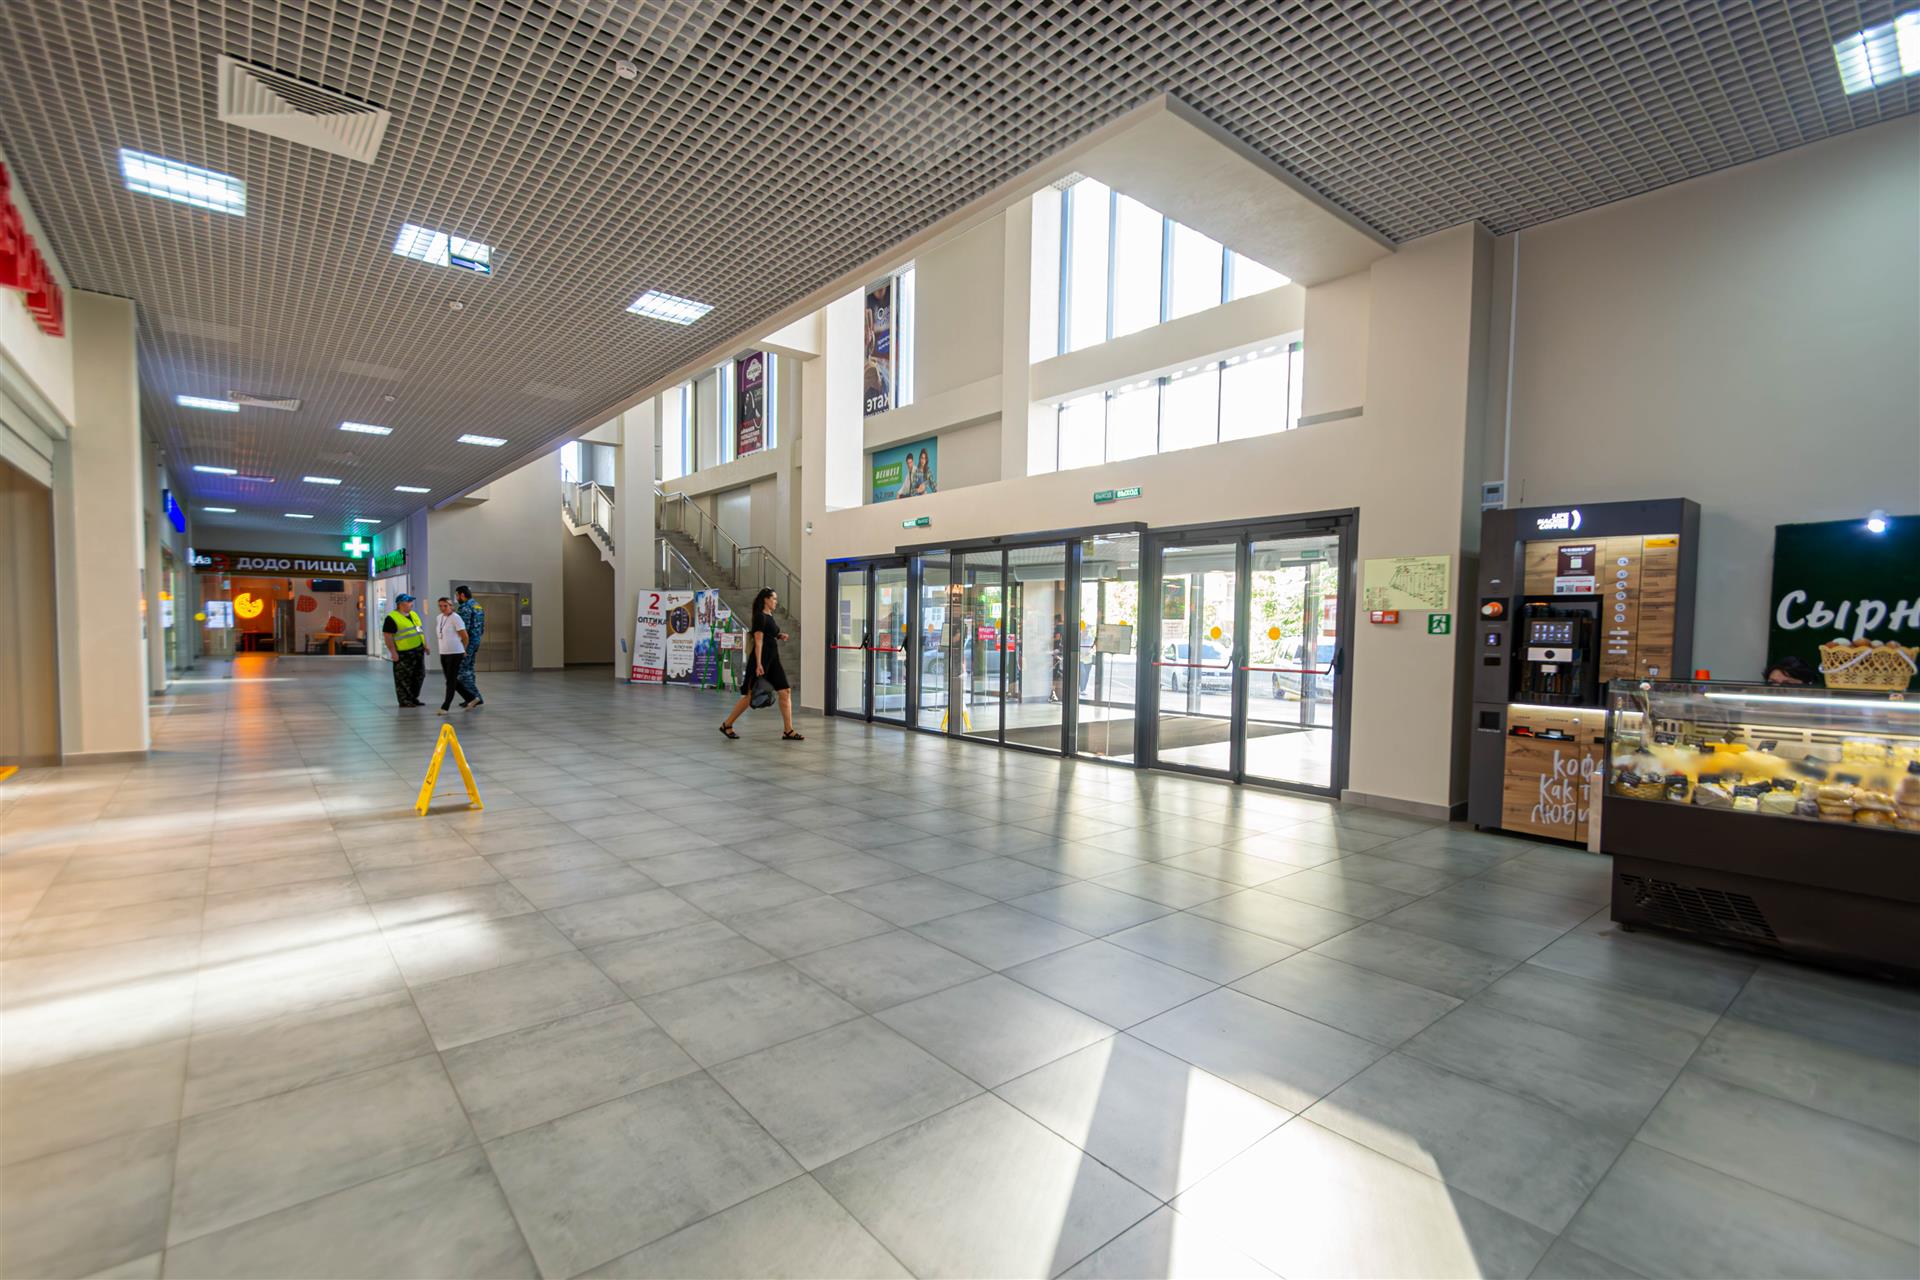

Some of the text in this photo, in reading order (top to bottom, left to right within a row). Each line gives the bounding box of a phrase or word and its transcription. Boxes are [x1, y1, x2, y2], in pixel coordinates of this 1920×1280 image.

[236, 557, 291, 570] ДОДО
[294, 559, 357, 573] ПИЦЦА
[649, 593, 660, 610] 2
